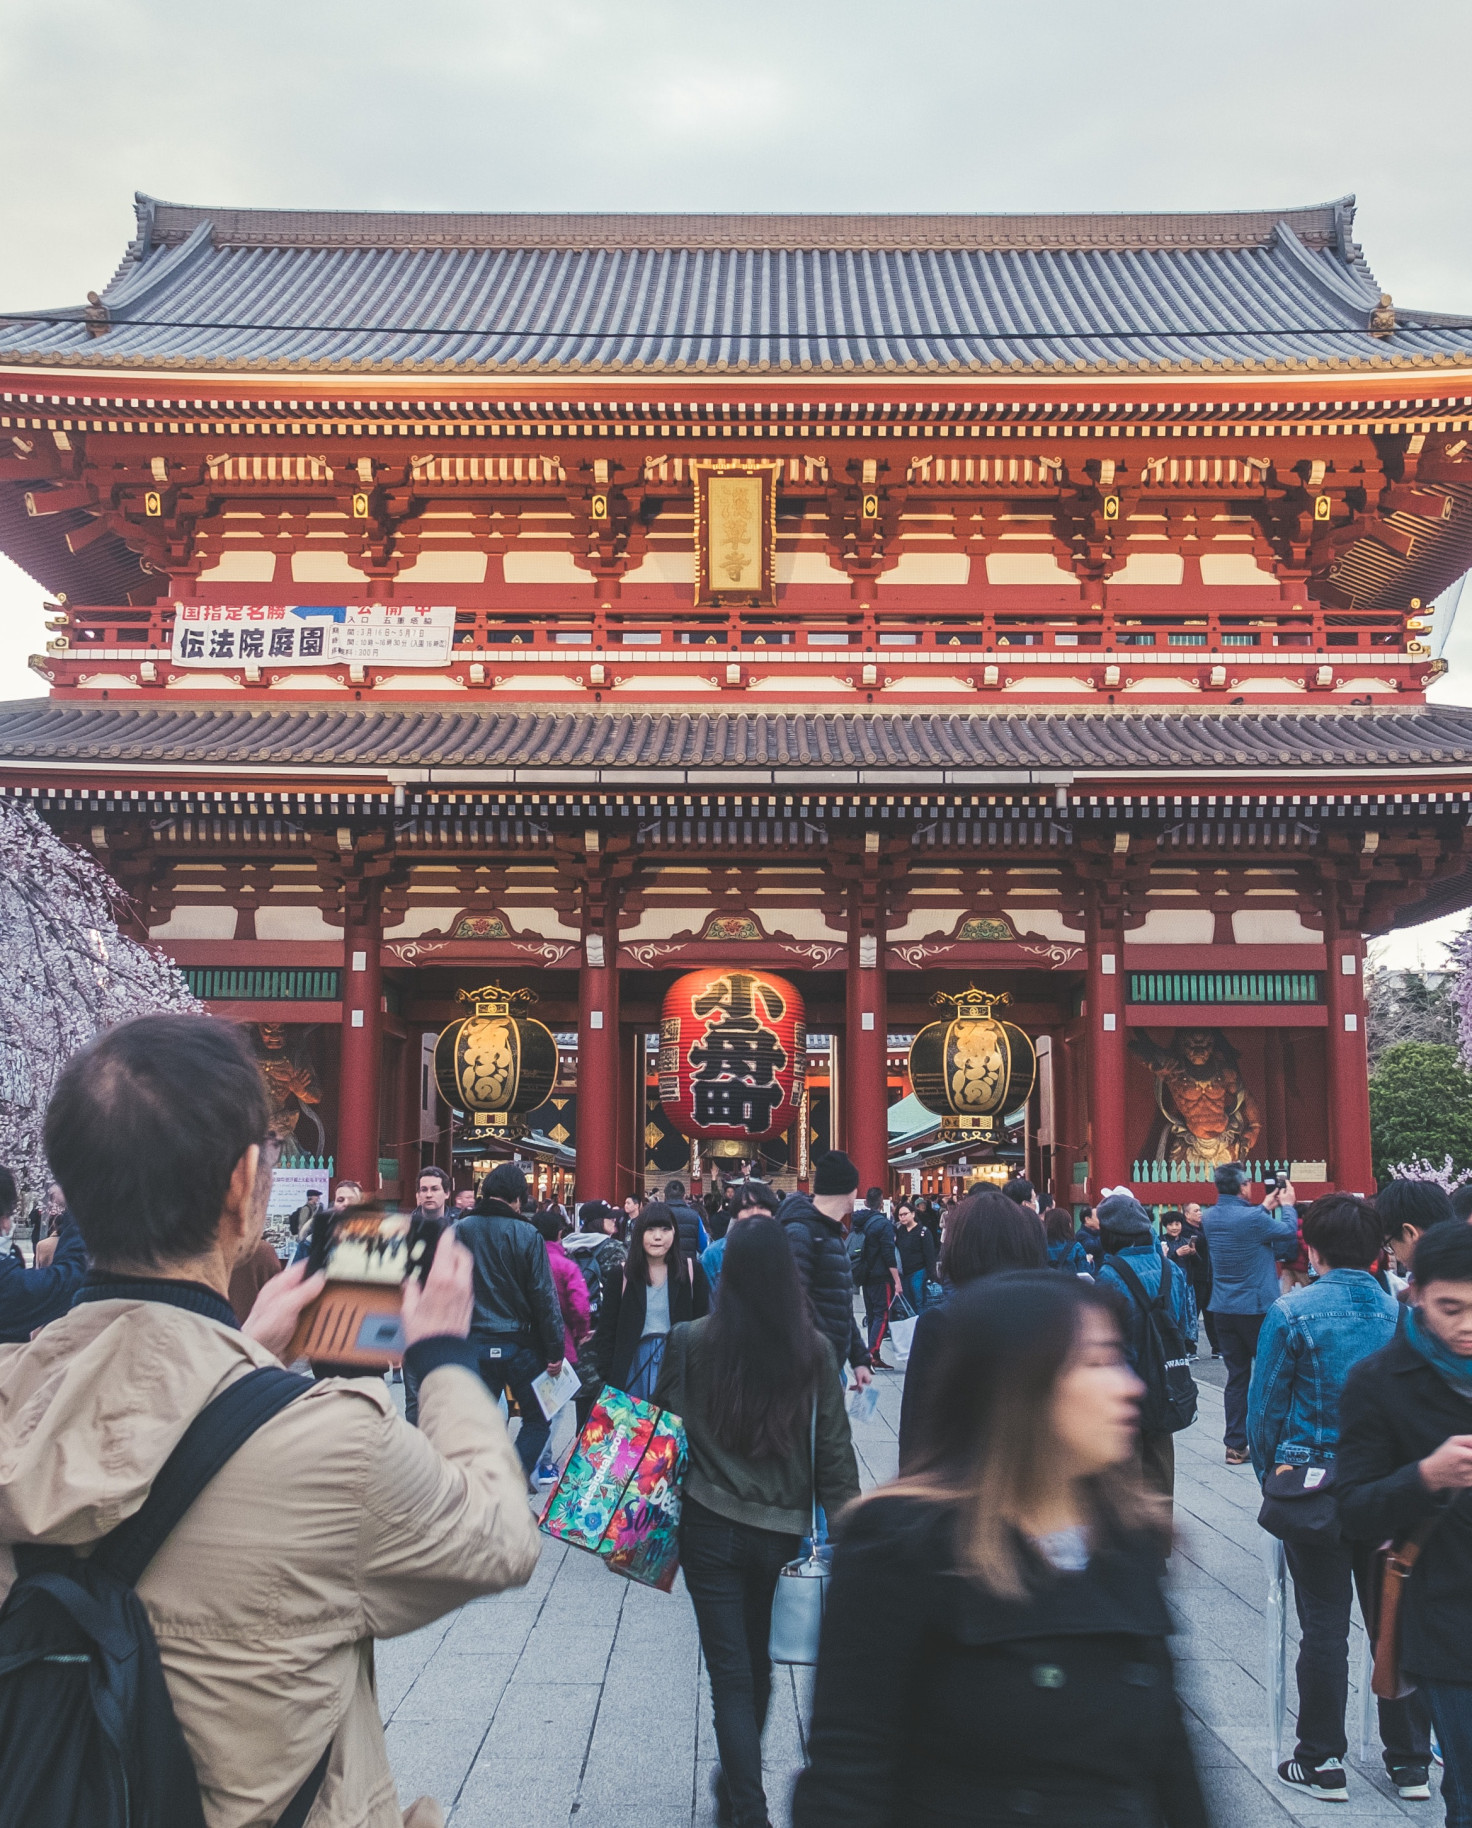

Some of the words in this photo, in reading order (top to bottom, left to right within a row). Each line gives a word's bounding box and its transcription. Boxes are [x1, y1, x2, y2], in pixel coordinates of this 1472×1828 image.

[182, 606, 286, 621] 国指定名勝
[347, 616, 369, 624] 入口
[180, 626, 324, 659] 伝法院庭園
[688, 973, 787, 1134] 小舟町
[580, 1424, 627, 1508] desigual.com
